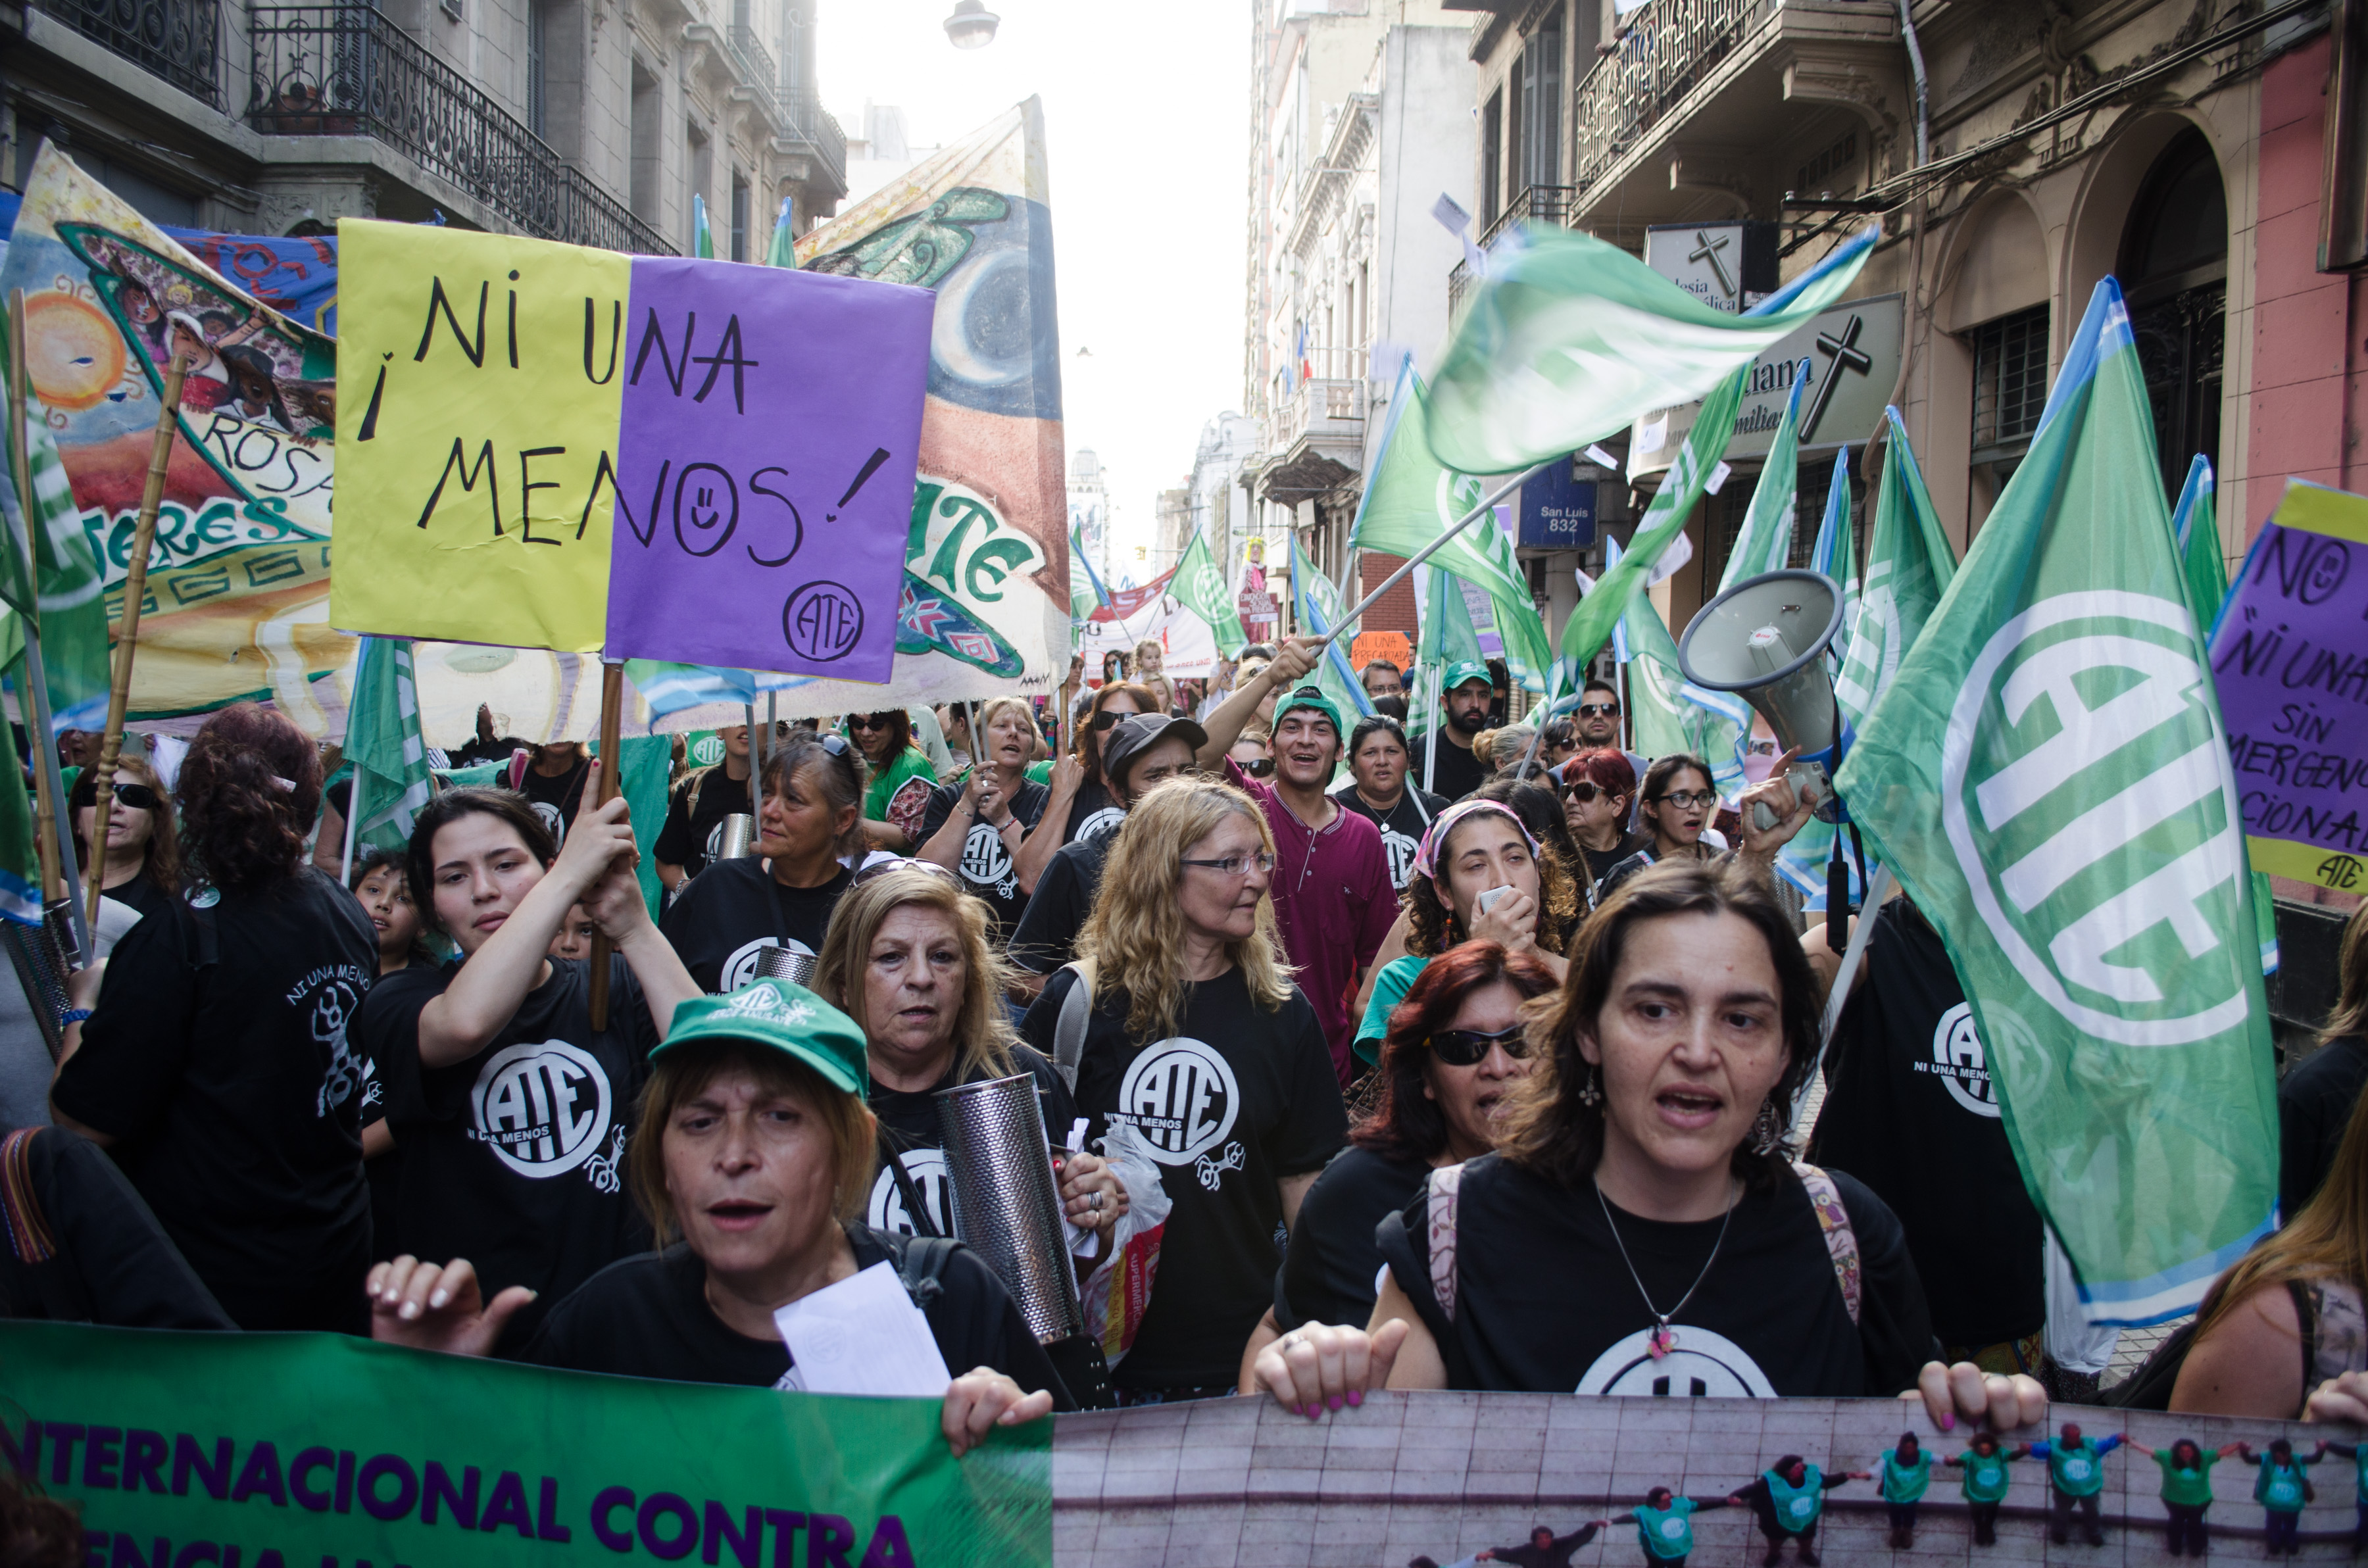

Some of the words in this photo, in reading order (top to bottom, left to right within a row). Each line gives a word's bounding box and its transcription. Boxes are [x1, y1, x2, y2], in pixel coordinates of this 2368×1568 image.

[583, 296, 758, 415] UNA
[1541, 506, 1562, 518] San
[1566, 507, 1588, 518] Luis
[1549, 518, 1578, 532] 832
[2253, 526, 2352, 606] NO
[796, 594, 855, 656] ATE
[1356, 635, 1368, 649] NI
[1375, 636, 1397, 648] UNA
[2271, 701, 2336, 744] SIN
[696, 737, 725, 762] ATE
[2316, 854, 2363, 889] ATE
[286, 980, 308, 1006] NI
[307, 964, 334, 986] UNA
[337, 964, 370, 991] MENO
[1914, 1061, 1927, 1072] NI
[1931, 1064, 1956, 1076] UNA
[487, 1053, 594, 1161] ATE
[1133, 1051, 1223, 1152] ATE
[503, 1125, 549, 1144] MENOS
[1141, 1117, 1182, 1129] MENOS
[591, 1484, 918, 1568] CONTRA
